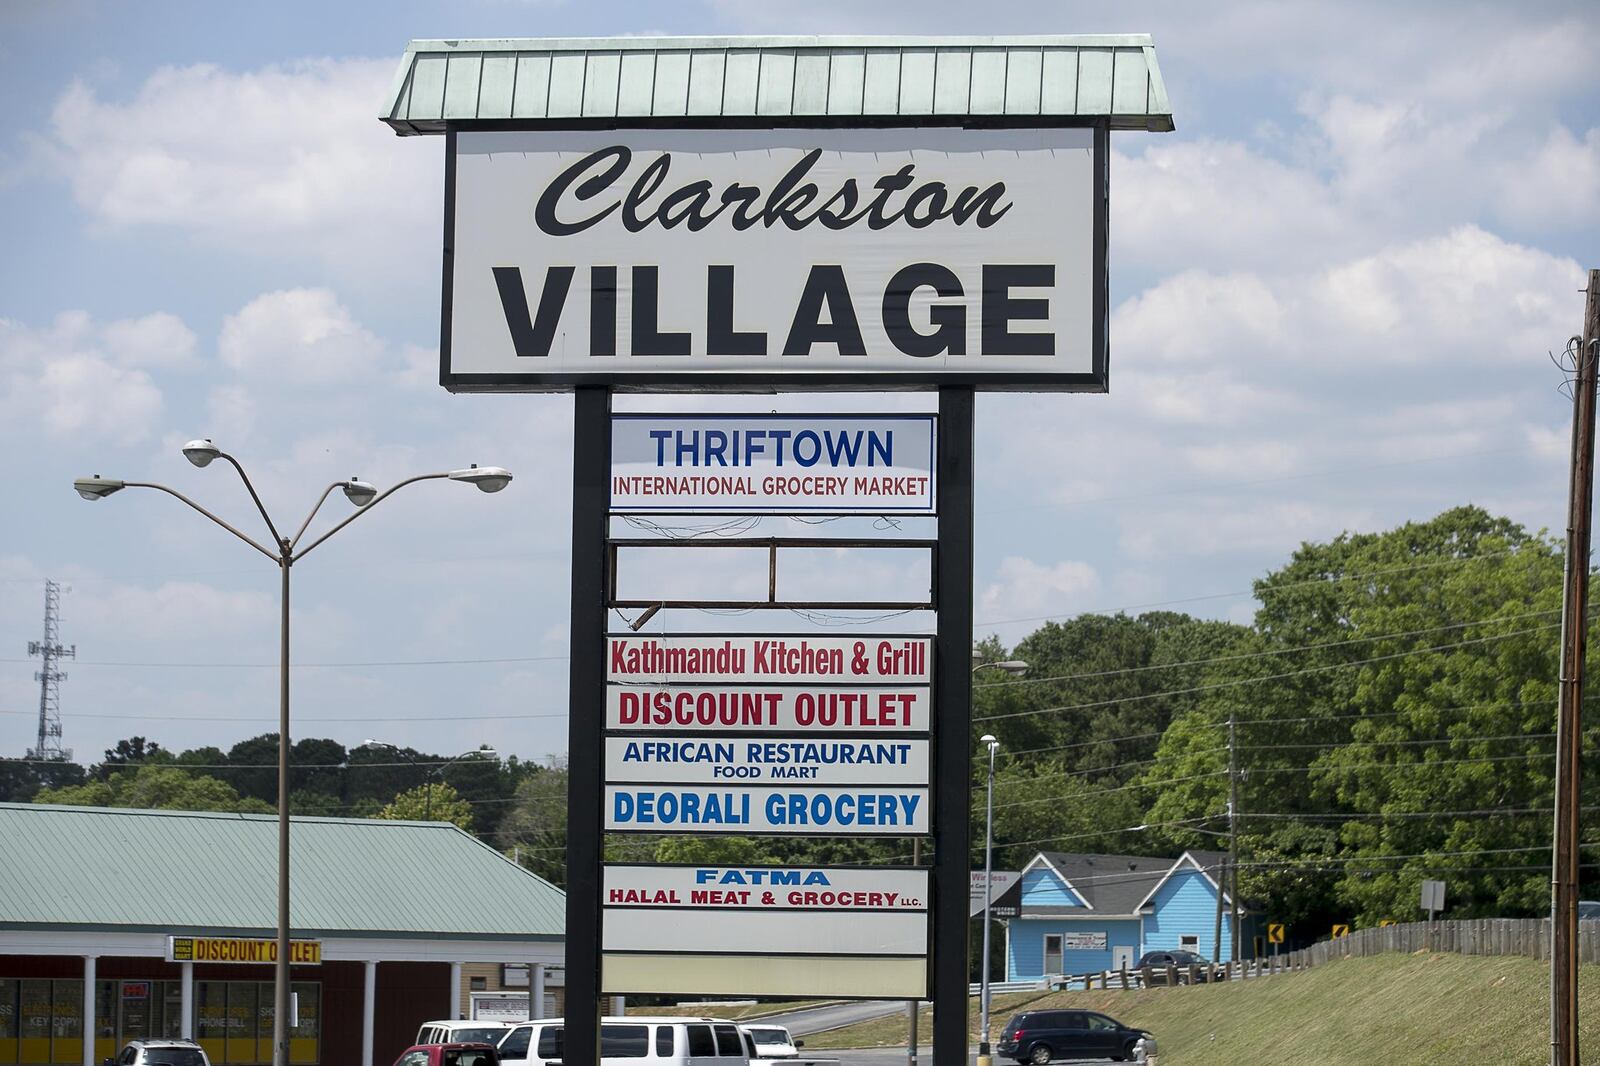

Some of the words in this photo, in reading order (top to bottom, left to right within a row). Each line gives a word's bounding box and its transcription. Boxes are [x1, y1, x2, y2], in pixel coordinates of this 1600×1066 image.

[534, 145, 1013, 236] Clarkston
[491, 262, 1056, 358] VILLAGE
[649, 430, 893, 467] THRIFTOWN
[613, 476, 757, 496] INTERNATIONAL
[762, 476, 849, 496] GROCERY
[854, 476, 928, 496] MARKET
[611, 640, 745, 674] Kathmandu
[753, 640, 843, 675] Kitchen
[850, 641, 869, 676] &
[877, 641, 925, 676] Grill
[619, 692, 783, 726] DISCOUNT
[794, 693, 917, 726] OUTLET
[623, 742, 733, 763] AFRICAN
[747, 743, 911, 764] RESTAURANT
[713, 766, 761, 778] FOOD
[771, 766, 819, 779] MART
[614, 791, 750, 824] DEORALI
[765, 793, 920, 826] GROCERY
[696, 869, 831, 886] FATMA
[609, 889, 681, 904] HALAL
[691, 890, 750, 905] MEAT
[761, 891, 775, 906] &
[788, 891, 899, 907] GROCERY
[901, 898, 922, 906] LLC.
[197, 939, 265, 961] DISCOUNT
[270, 941, 319, 962] OTLET
[30, 1016, 49, 1026] KEY
[53, 1016, 79, 1027] COPY
